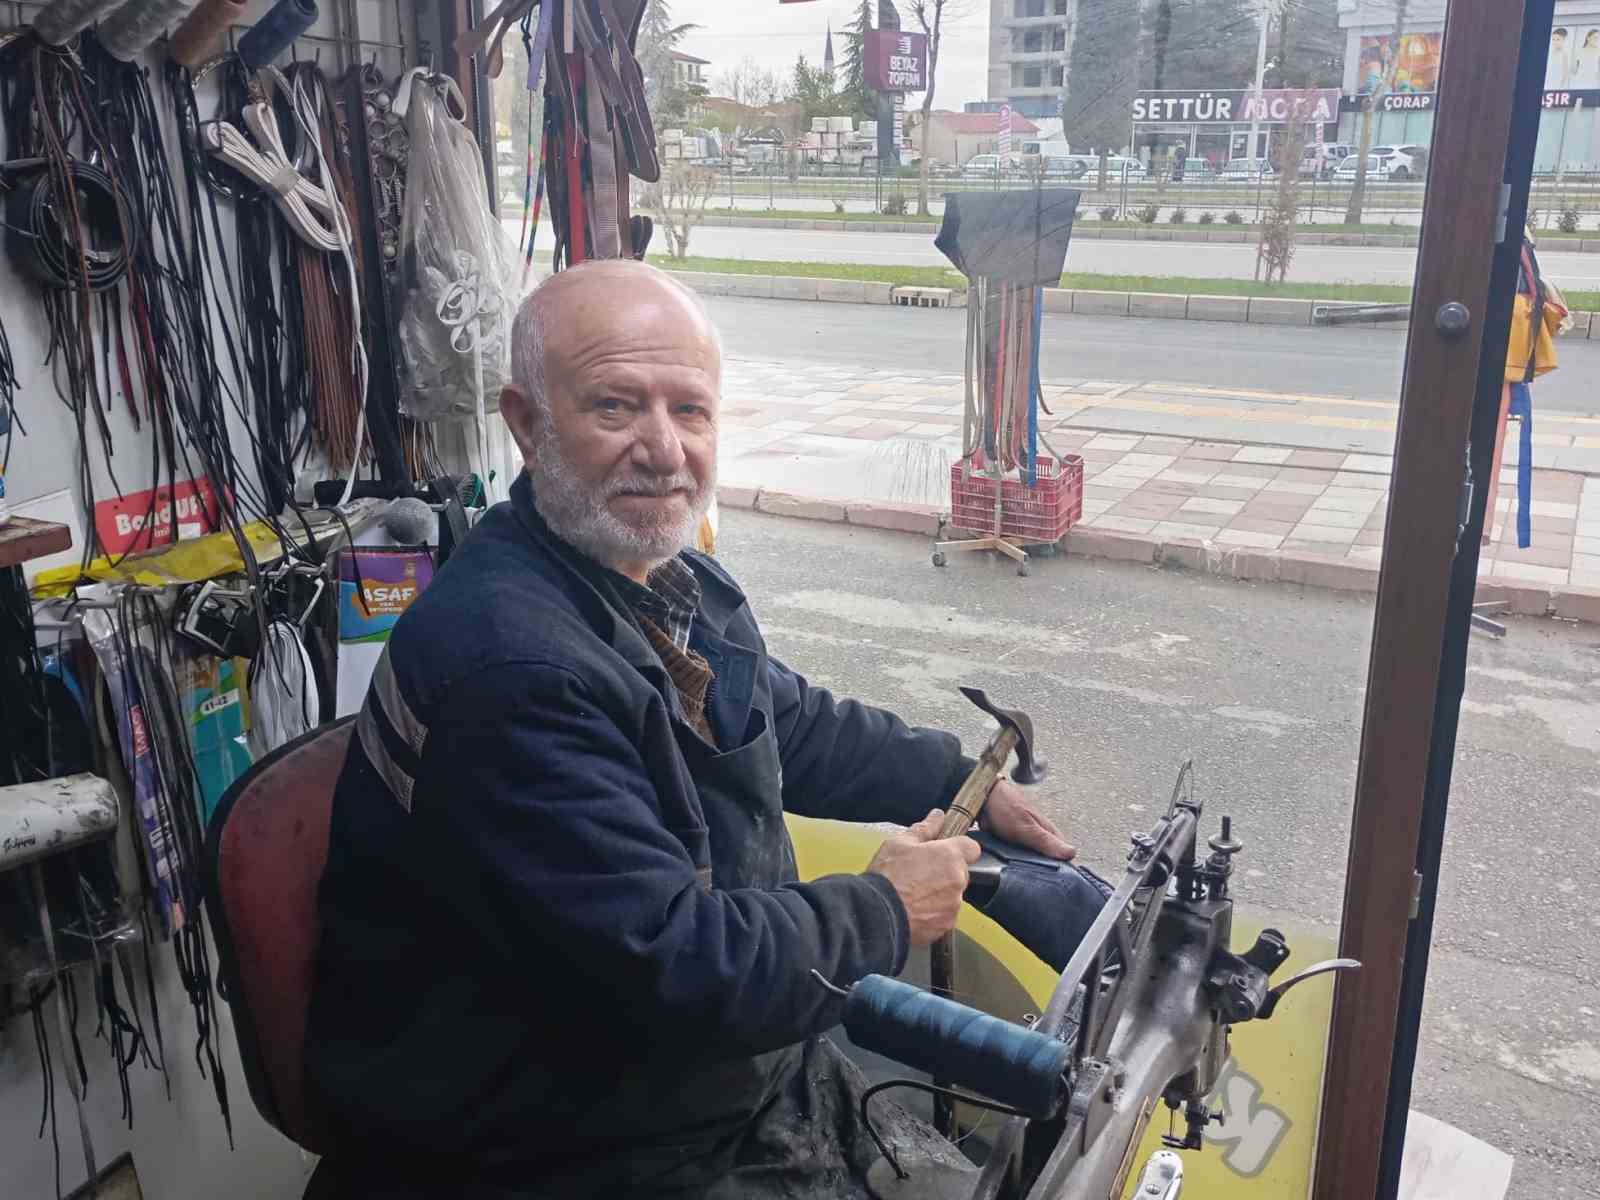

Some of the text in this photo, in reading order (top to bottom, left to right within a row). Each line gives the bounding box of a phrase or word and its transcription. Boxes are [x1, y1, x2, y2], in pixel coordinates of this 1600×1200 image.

[889, 55, 918, 72] BEYAZ
[888, 71, 921, 88] TOPTAN
[1132, 93, 1231, 120] SETTÜR
[1384, 96, 1431, 111] ÇORAP
[1541, 92, 1571, 108] ŞIR
[363, 586, 415, 603] ASAF
